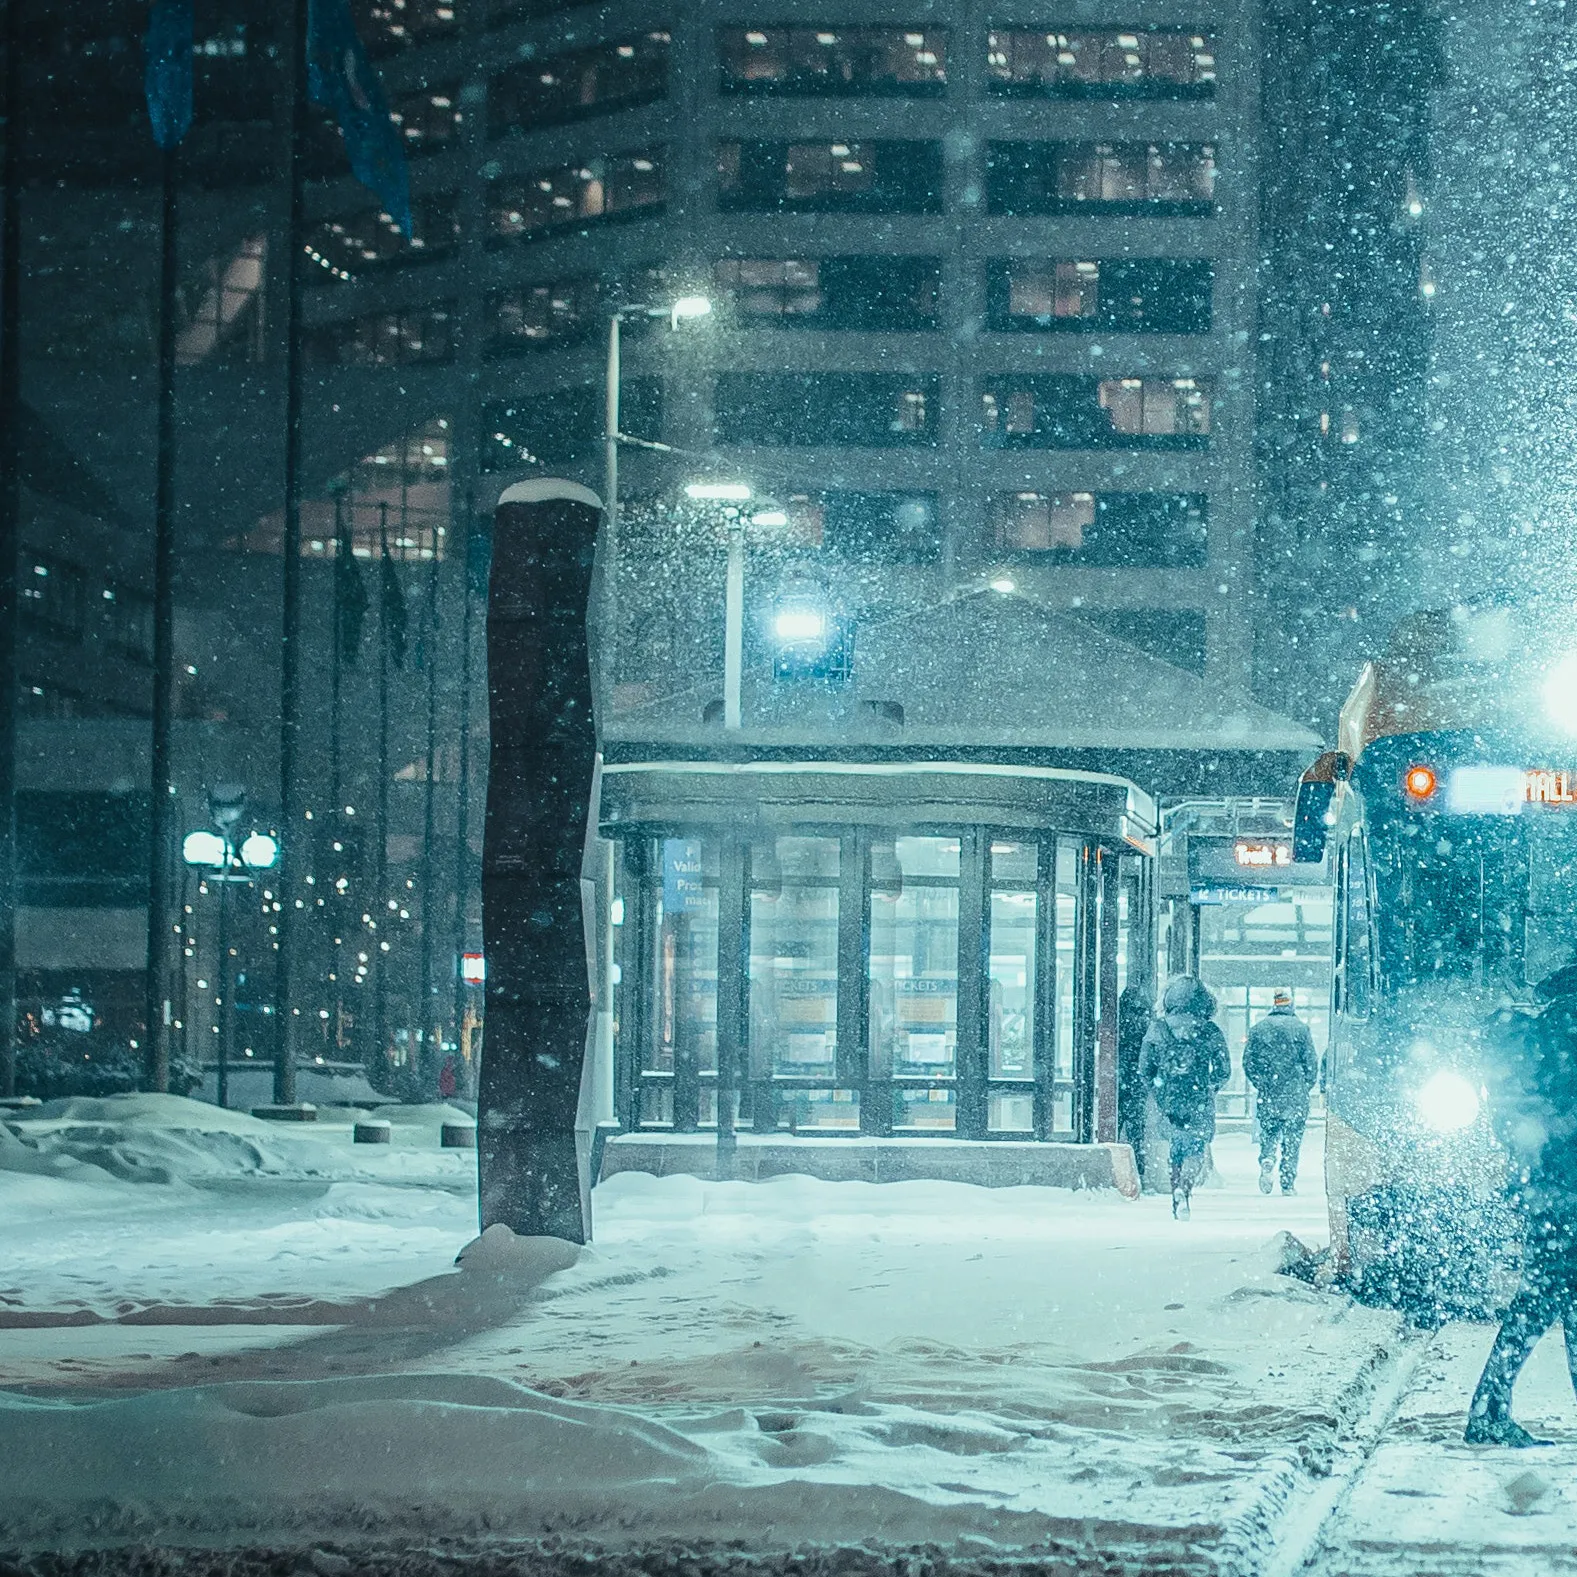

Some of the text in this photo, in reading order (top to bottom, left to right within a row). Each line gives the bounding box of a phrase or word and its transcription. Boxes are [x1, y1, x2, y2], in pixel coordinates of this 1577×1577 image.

[1523, 774, 1573, 801] MALL
[674, 861, 702, 872] Valid
[1217, 889, 1271, 900] TICKETS
